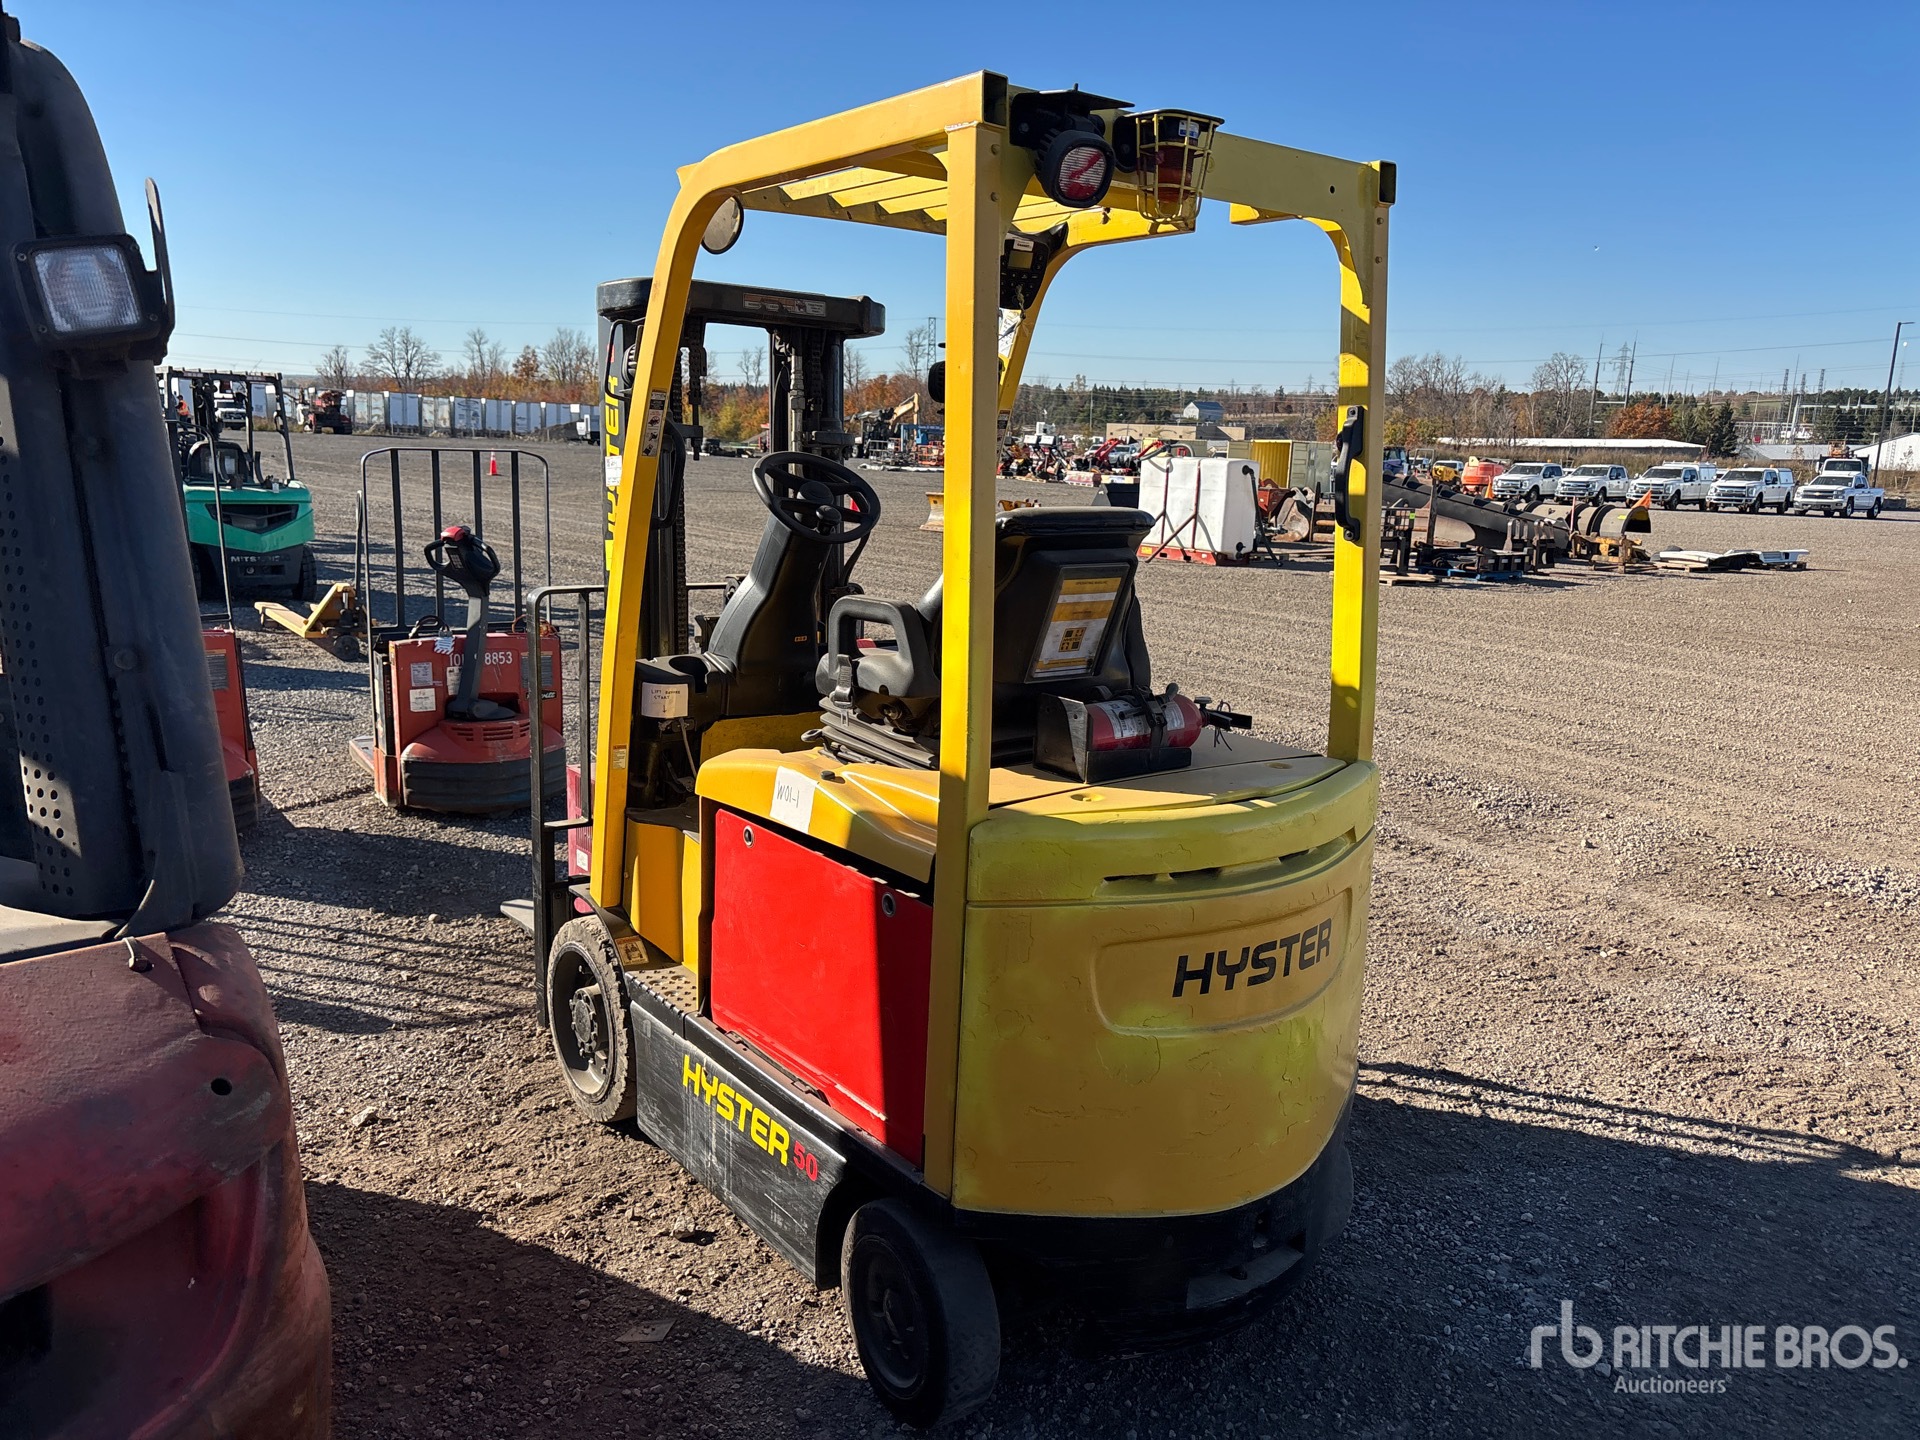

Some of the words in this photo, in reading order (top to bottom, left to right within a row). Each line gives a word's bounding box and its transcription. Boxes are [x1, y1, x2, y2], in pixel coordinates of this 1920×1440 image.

[484, 652, 513, 666] 8853
[1172, 917, 1332, 997] HYSTER
[683, 1054, 790, 1166] HYSTER
[793, 1140, 818, 1182] 50
